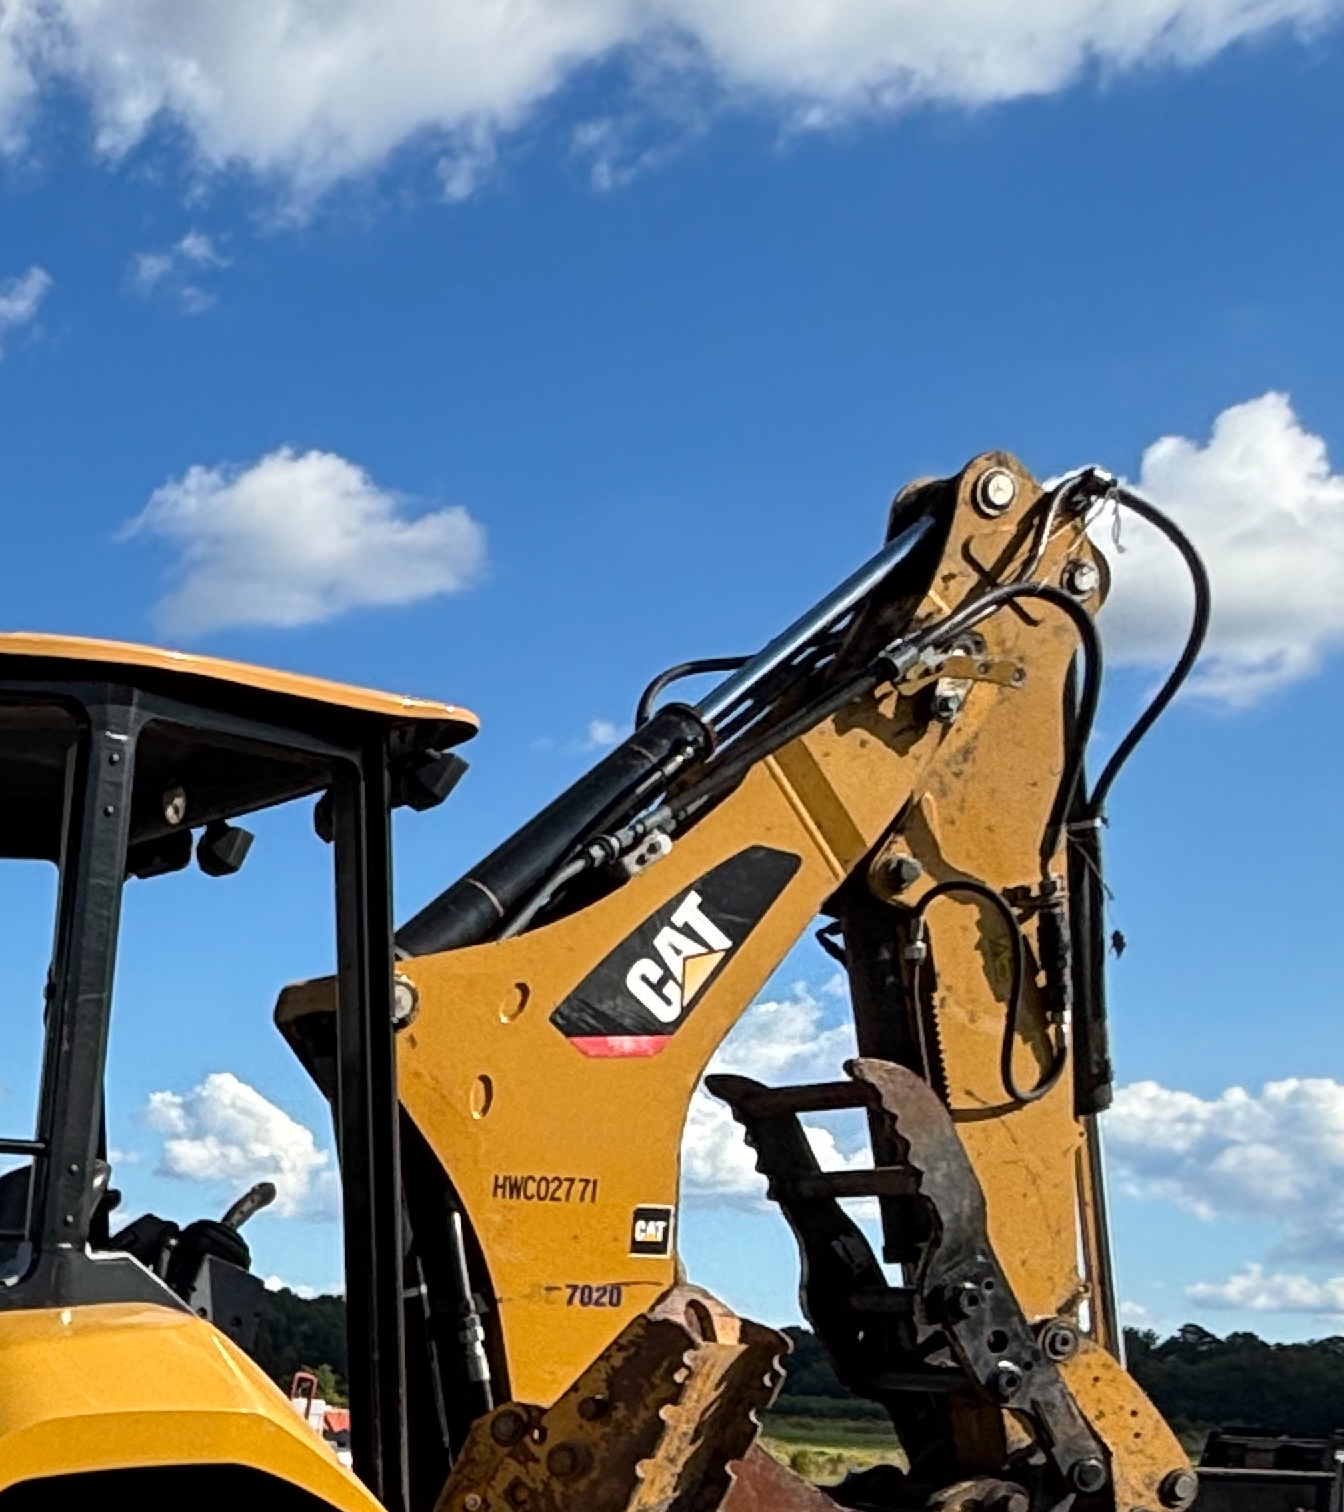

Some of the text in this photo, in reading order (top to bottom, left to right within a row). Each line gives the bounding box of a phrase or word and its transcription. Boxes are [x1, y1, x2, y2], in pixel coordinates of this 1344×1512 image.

[626, 891, 733, 1023] CAT
[492, 1174, 598, 1203] HWC02771
[634, 1219, 667, 1242] CAT
[565, 1284, 623, 1307] 7020
